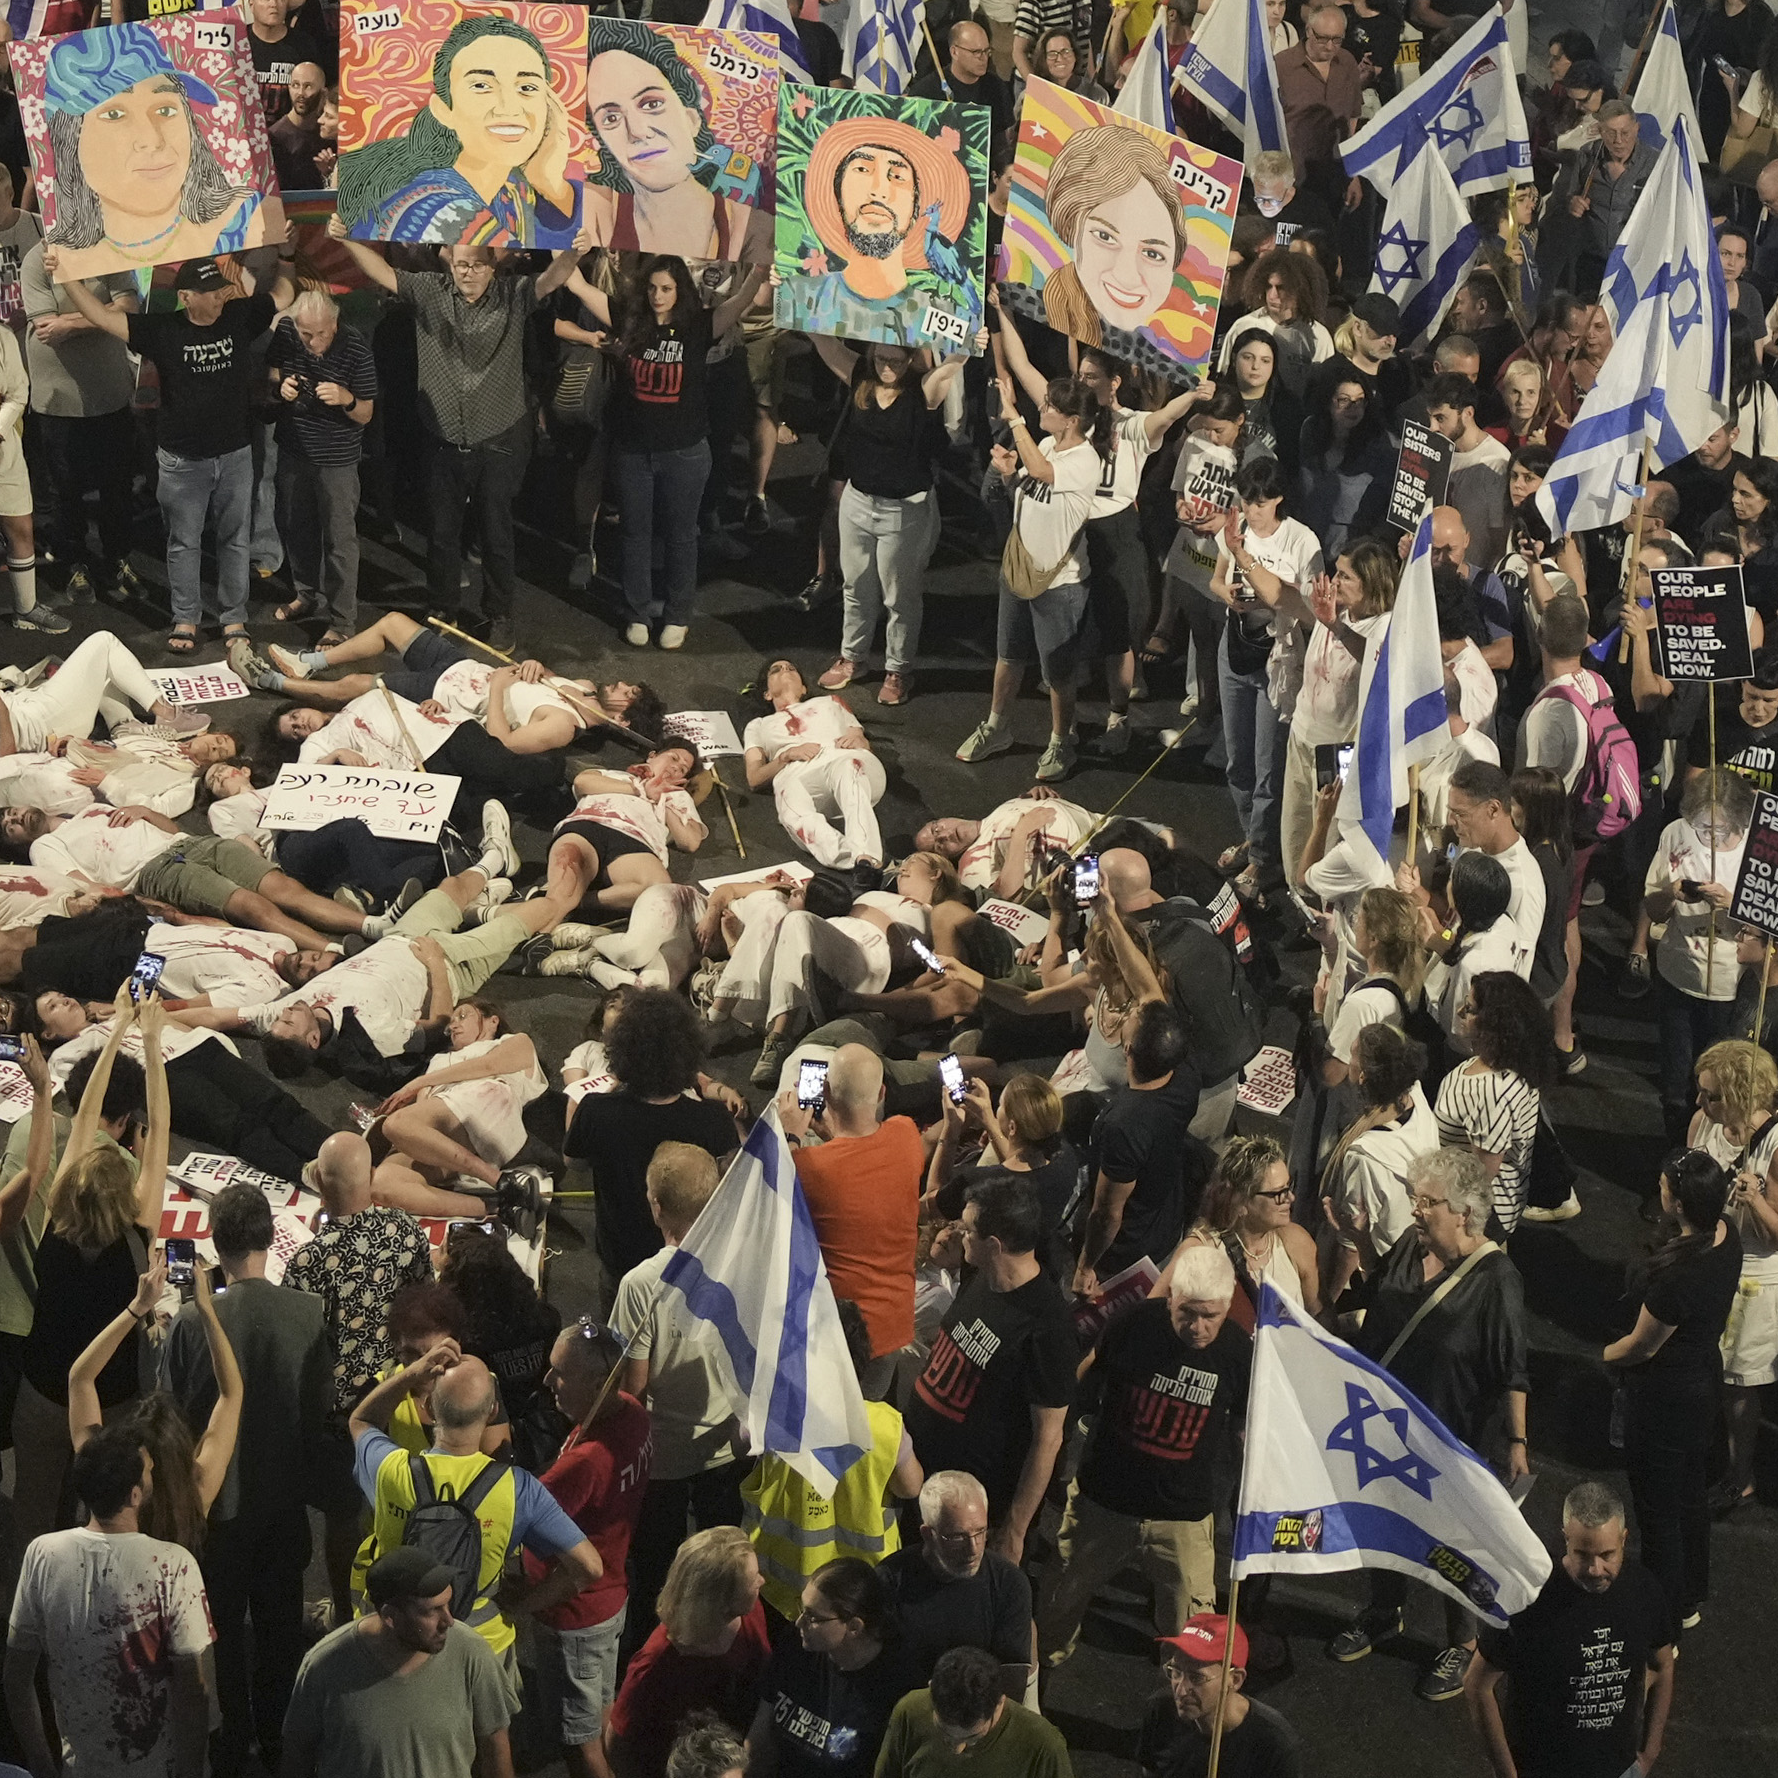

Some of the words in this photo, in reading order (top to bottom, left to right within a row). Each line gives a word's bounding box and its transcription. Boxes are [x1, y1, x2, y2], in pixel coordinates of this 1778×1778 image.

[357, 13, 400, 30] נועה
[197, 26, 231, 47] לירי
[710, 47, 759, 80] כרמל
[1174, 164, 1226, 209] קרינה
[926, 310, 964, 340] ביפין
[191, 360, 232, 373] באוקטובר
[1405, 426, 1428, 444] OUR
[1404, 438, 1441, 462] SISTERS
[1203, 461, 1234, 487] אתה
[1397, 481, 1426, 502] SAVED
[1394, 492, 1417, 512] STOP
[1392, 503, 1410, 520] THE
[1657, 572, 1694, 585] OUR
[1659, 583, 1727, 599] PEOPLE
[1665, 625, 1688, 637] TO
[1692, 625, 1715, 637] BE
[1667, 637, 1727, 651] SAVED.
[1669, 651, 1715, 664] DEAL
[1670, 663, 1715, 677] NOW.
[278, 771, 329, 789] רעב
[344, 775, 438, 800] שובתת
[1748, 857, 1772, 877] TO
